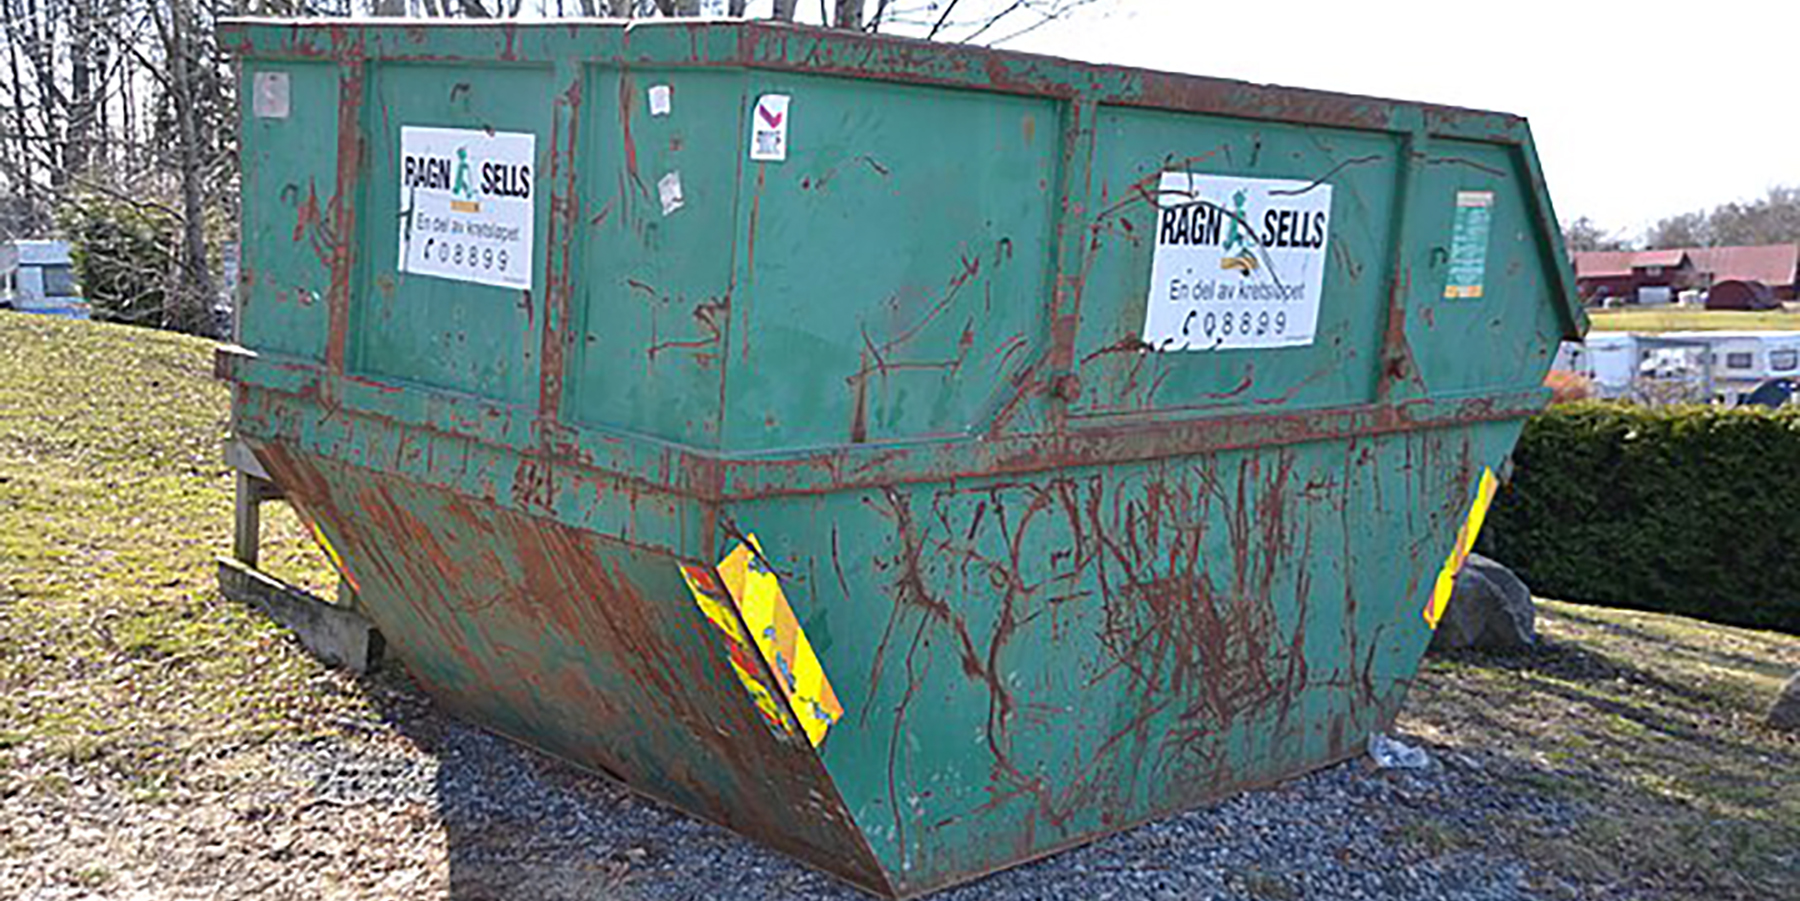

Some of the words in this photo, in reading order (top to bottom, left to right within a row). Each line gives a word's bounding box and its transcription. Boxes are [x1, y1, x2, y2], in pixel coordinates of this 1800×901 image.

[405, 156, 451, 190] RAGN
[481, 162, 531, 199] SELLS
[416, 212, 430, 231] En
[1160, 206, 1222, 246] RAGN
[1262, 209, 1326, 249] SELLS
[1170, 279, 1189, 300] En
[1194, 279, 1216, 300] del
[1217, 284, 1235, 300] av
